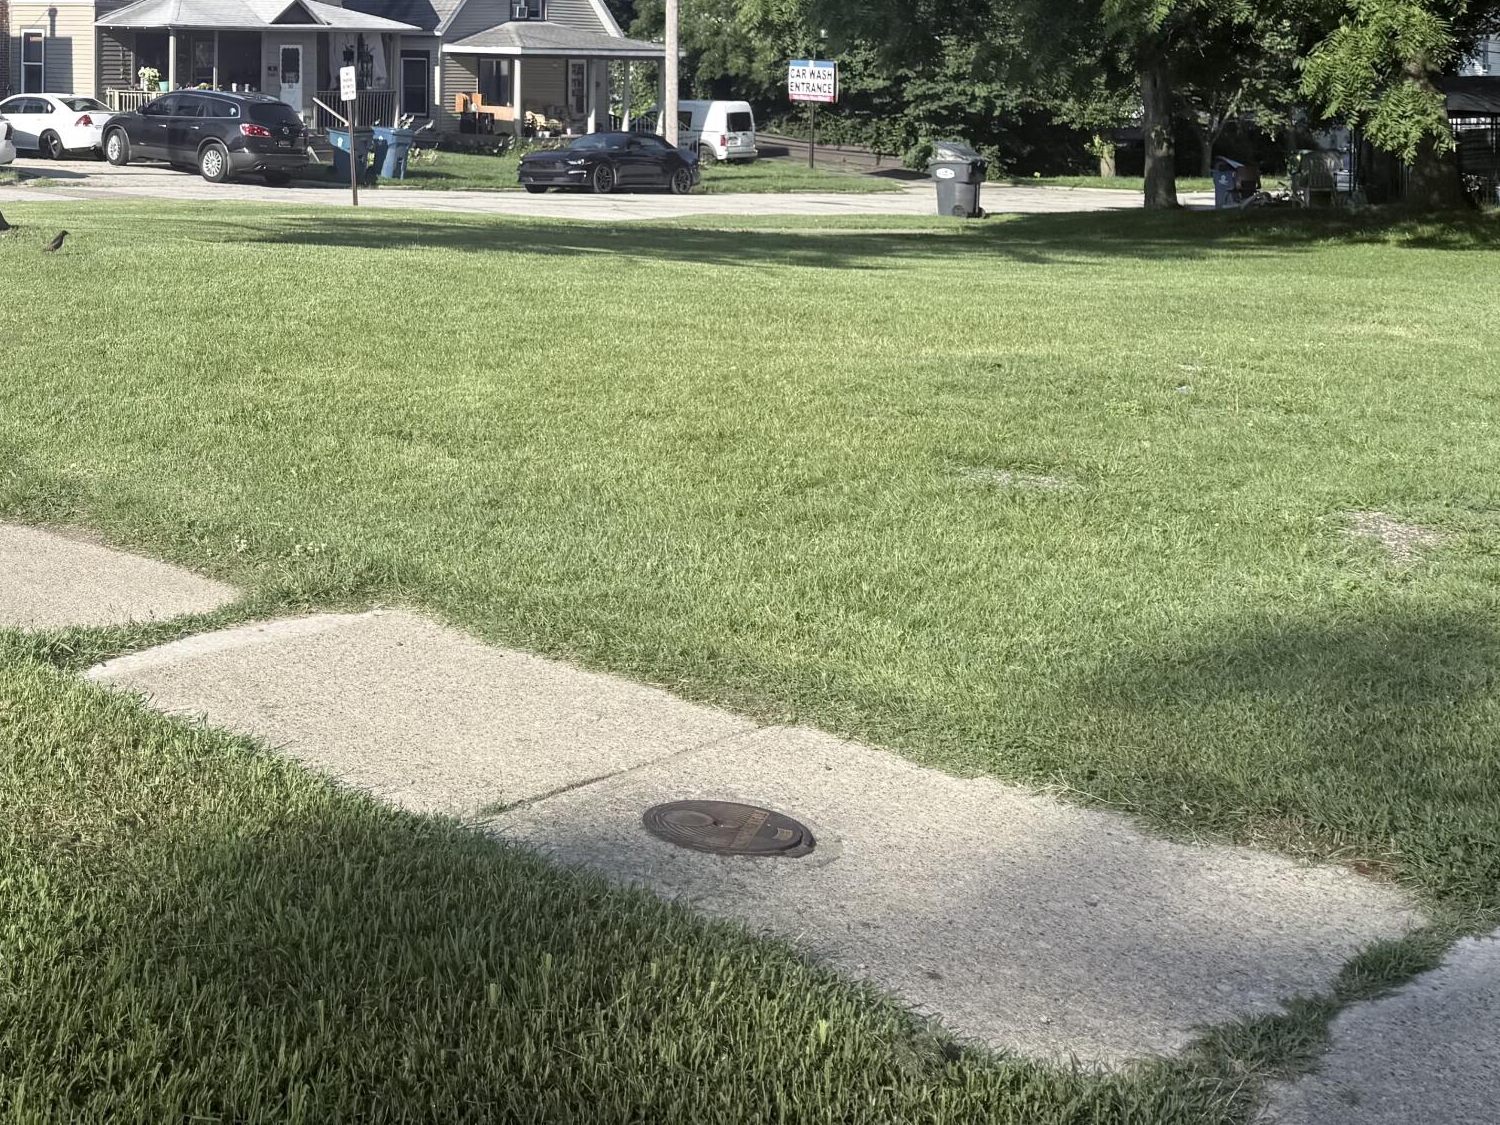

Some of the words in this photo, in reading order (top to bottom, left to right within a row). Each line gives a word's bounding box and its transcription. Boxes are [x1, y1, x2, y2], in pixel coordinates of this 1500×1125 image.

[790, 68, 807, 79] CAR
[810, 69, 833, 80] WASH
[790, 82, 832, 93] ENTRANCE
